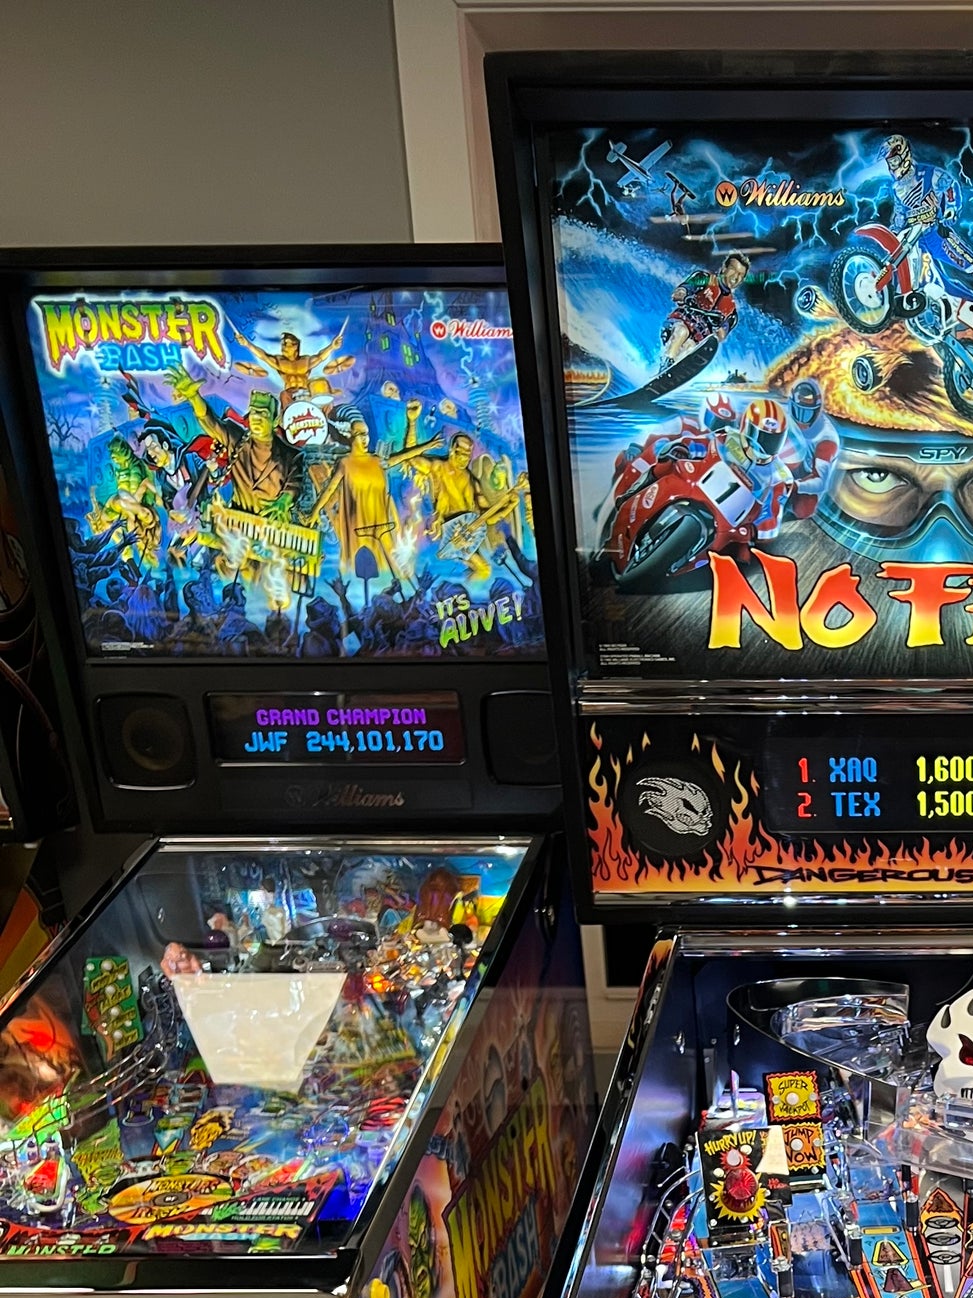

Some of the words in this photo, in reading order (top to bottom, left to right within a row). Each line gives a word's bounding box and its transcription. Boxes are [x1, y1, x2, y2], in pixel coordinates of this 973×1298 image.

[740, 178, 846, 207] Williams
[43, 302, 227, 367] MONSTER
[97, 343, 183, 369] BASH
[919, 445, 967, 462] SPY
[714, 482, 742, 505] 1
[435, 594, 471, 621] IT'S
[706, 548, 879, 652] NO
[439, 592, 522, 649] ALIVE!
[256, 709, 320, 726] GRAND
[326, 708, 427, 726] CHAMPION
[244, 731, 288, 752] JWF
[306, 730, 444, 753] 244,101,170
[798, 757, 817, 783] 1.
[829, 757, 877, 783] XAQ
[797, 792, 817, 818] 2.
[830, 791, 881, 818] TEX
[778, 1079, 809, 1096] SUPER
[703, 1133, 738, 1157] HURRY
[738, 1130, 757, 1145] UP!
[784, 1127, 815, 1146] JUMP
[146, 1223, 302, 1240] MONSTER
